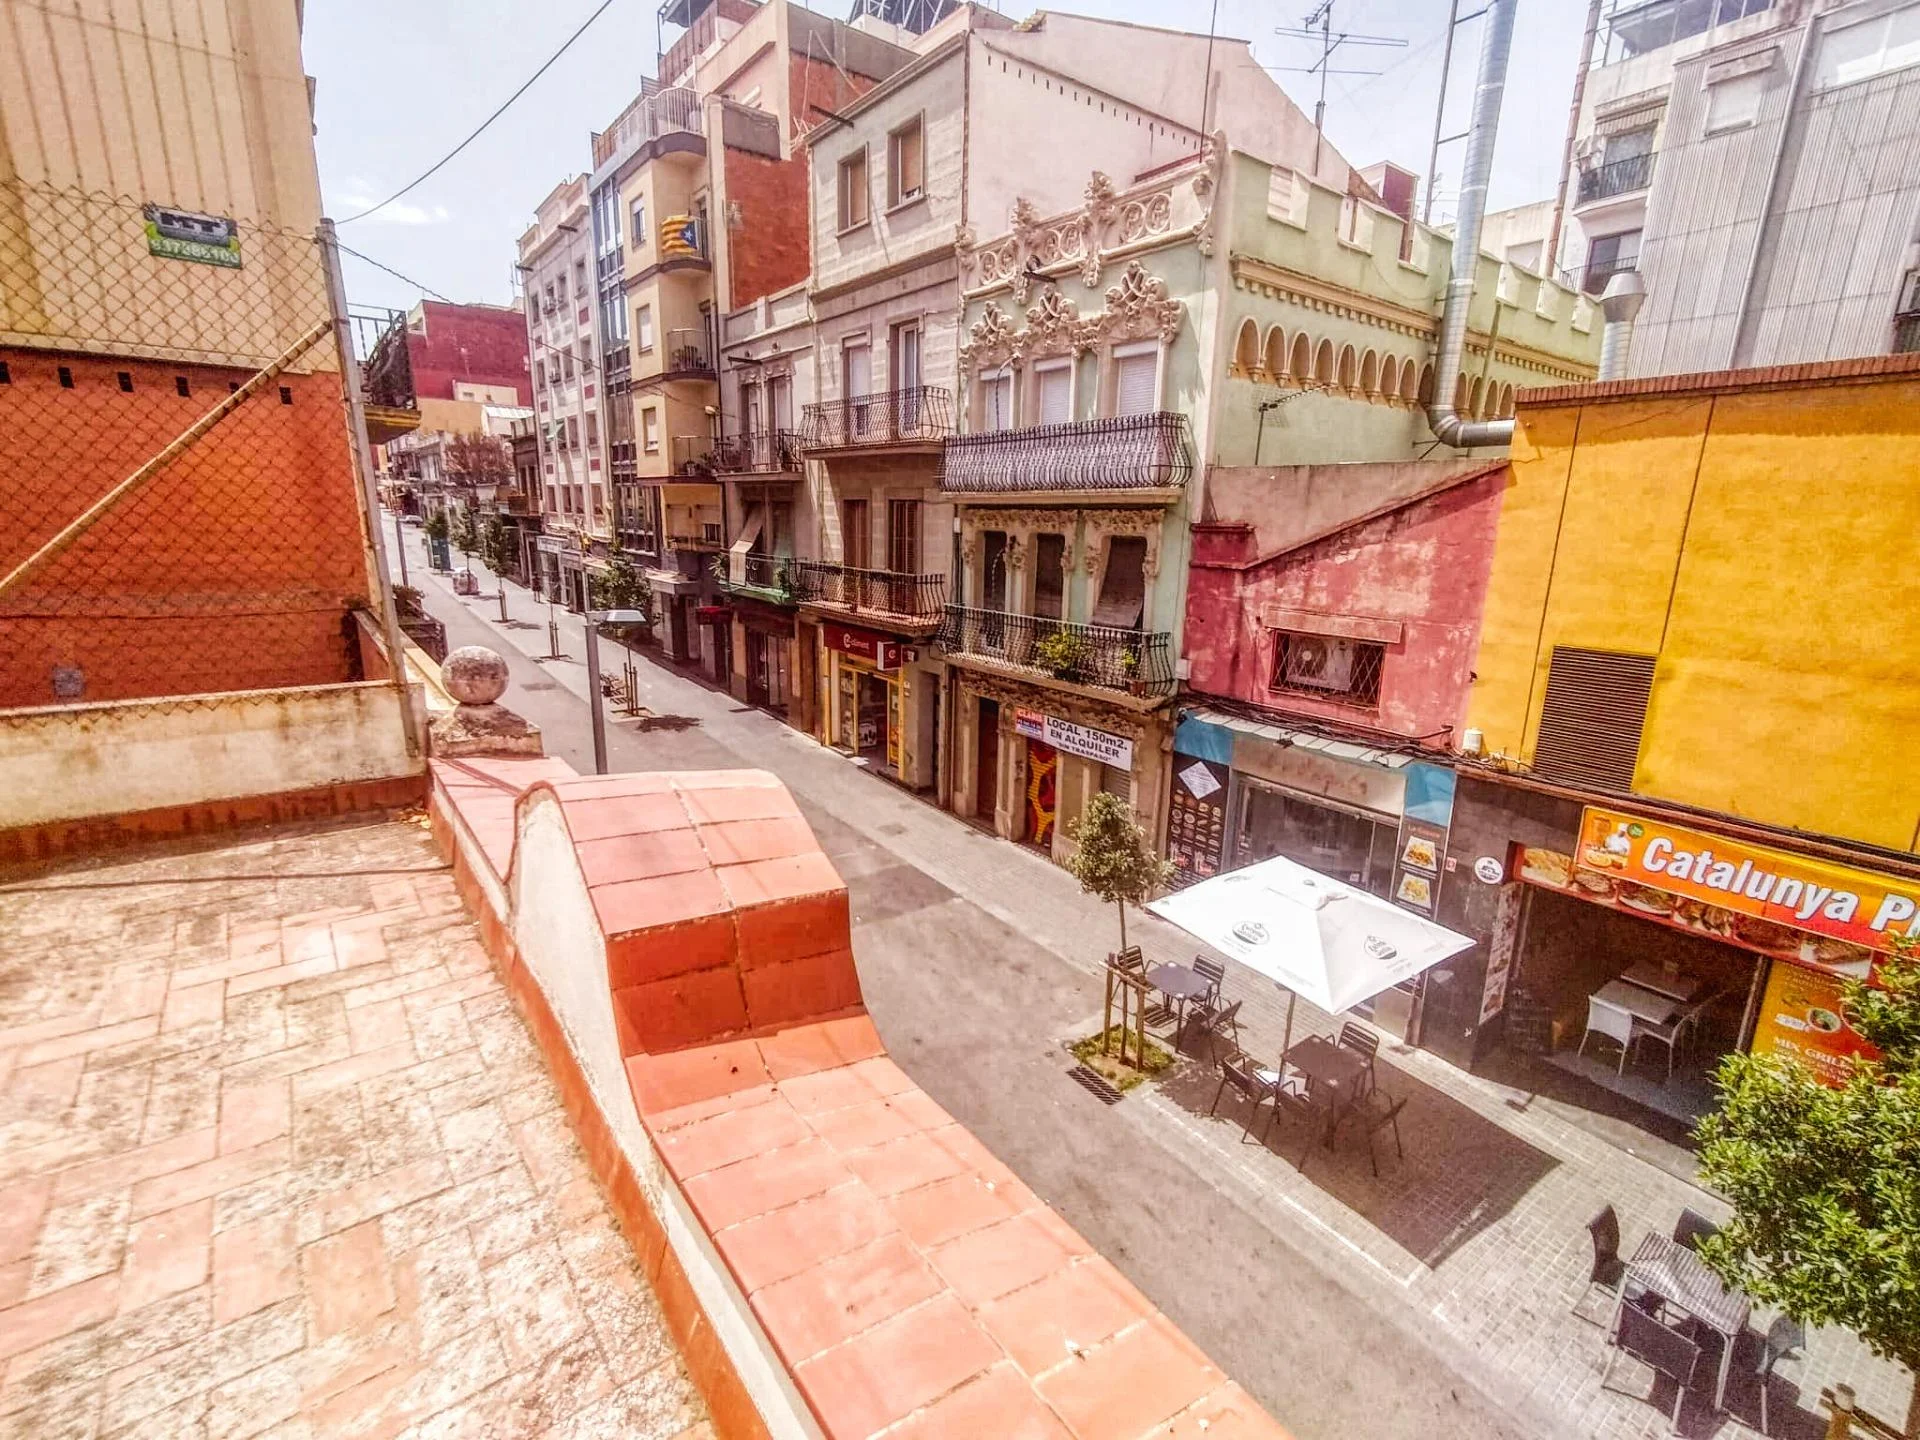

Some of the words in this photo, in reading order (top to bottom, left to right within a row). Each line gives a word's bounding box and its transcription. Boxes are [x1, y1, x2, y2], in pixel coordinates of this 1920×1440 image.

[1046, 717, 1080, 736] LOCAL
[1086, 728, 1128, 751] 150m2.
[1050, 729, 1062, 740] EN
[1065, 734, 1120, 758] ALQUILER
[1642, 837, 1859, 922] Catalunya
